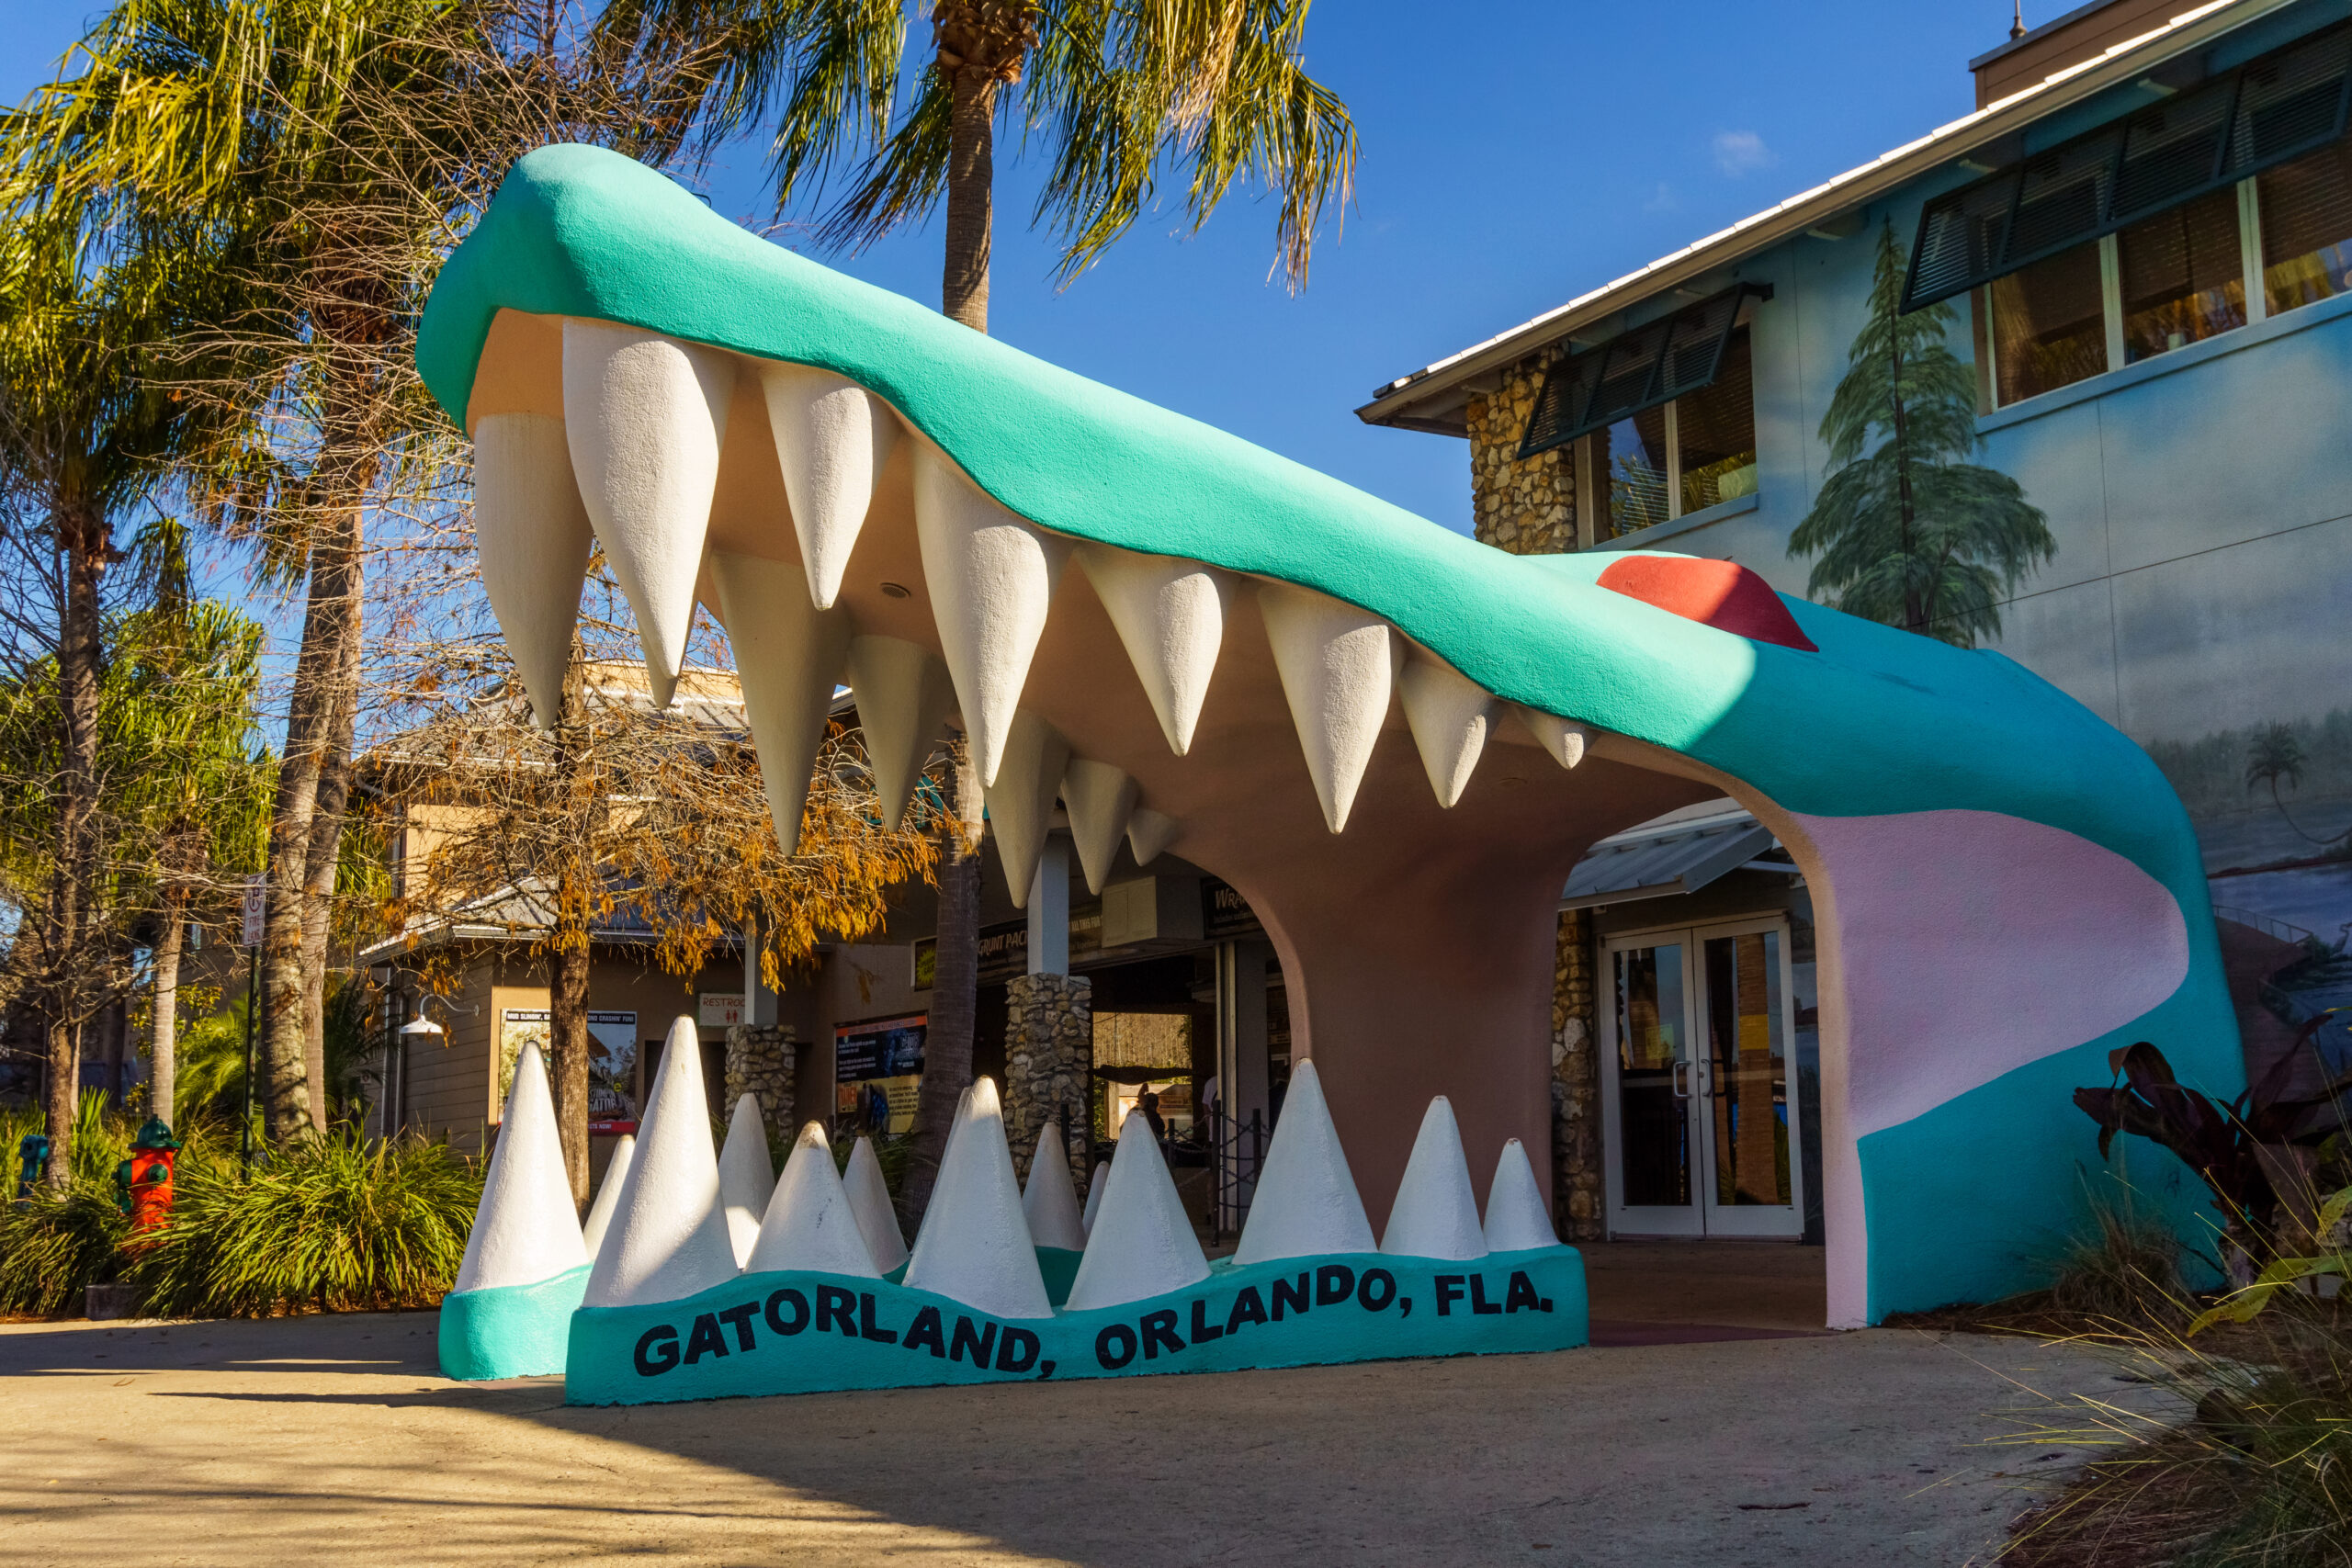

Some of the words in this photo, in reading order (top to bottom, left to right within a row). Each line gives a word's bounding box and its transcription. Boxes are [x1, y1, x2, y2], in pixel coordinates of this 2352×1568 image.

[978, 934, 1004, 956] GRUNT
[703, 998, 745, 1007] RESTROO
[634, 1283, 1057, 1380] GATORLAND,
[1094, 1264, 1413, 1371] ORLANDO,
[1434, 1270, 1554, 1317] FLA.
